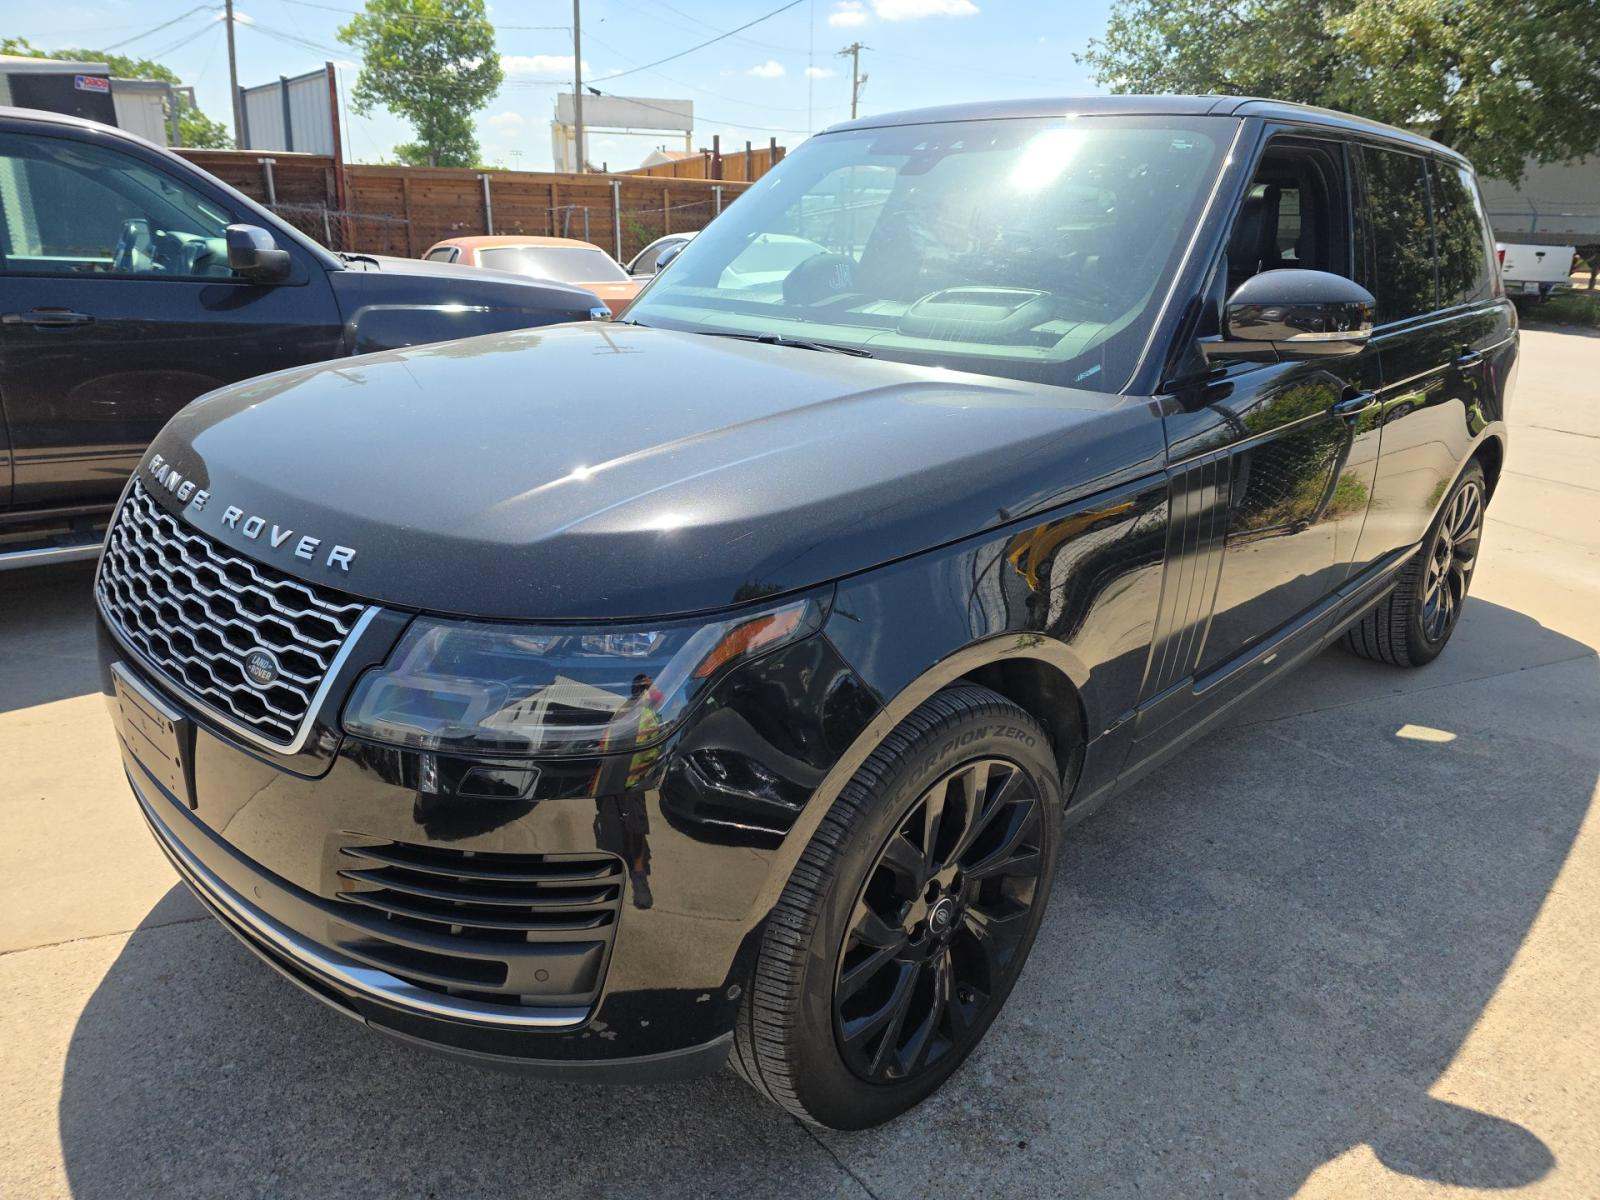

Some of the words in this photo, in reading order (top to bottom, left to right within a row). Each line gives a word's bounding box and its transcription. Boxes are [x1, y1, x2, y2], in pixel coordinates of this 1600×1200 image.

[149, 453, 211, 512] RANGE
[221, 505, 356, 571] ROVER
[251, 655, 269, 669] LAND
[250, 666, 272, 681] ROVER
[992, 725, 1036, 748] ZERO
